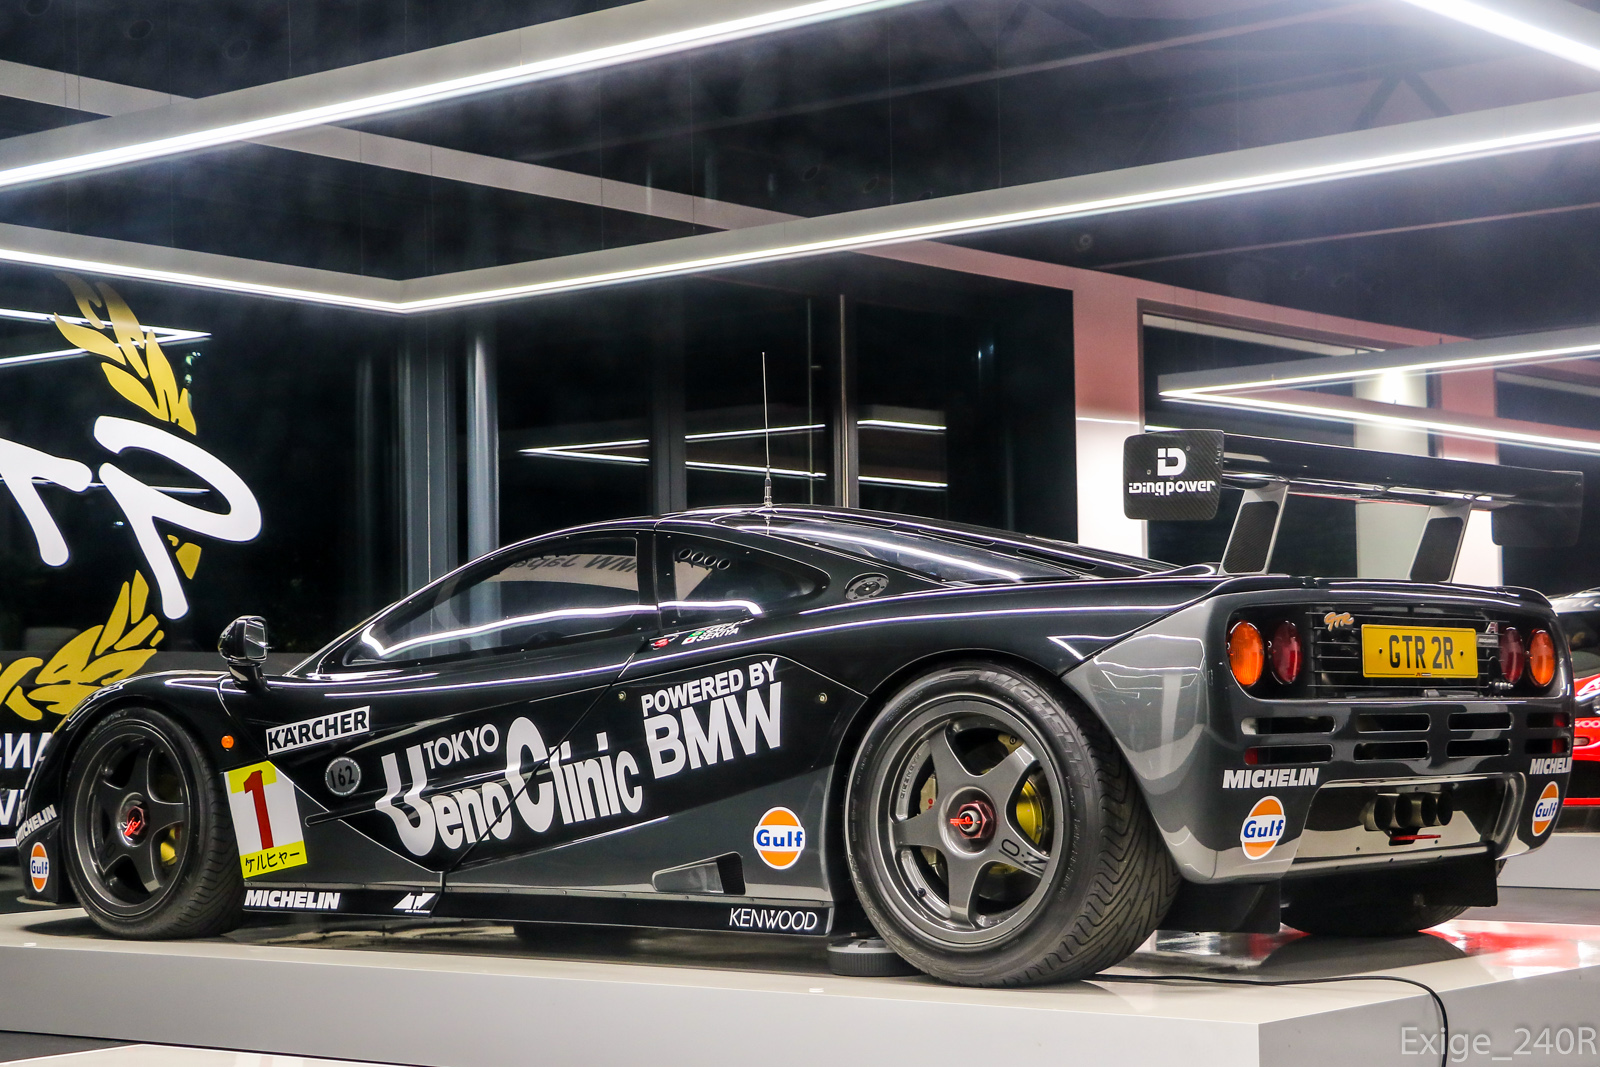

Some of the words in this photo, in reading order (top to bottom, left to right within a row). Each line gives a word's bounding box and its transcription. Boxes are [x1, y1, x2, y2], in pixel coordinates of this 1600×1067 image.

[1324, 612, 1354, 631] GTR
[1389, 634, 1426, 669] GTR
[1431, 636, 1454, 669] 2R
[641, 670, 744, 718] POWERED
[749, 657, 779, 688] BY
[268, 710, 368, 752] KÄRCHER
[643, 681, 783, 779] BMW
[424, 723, 500, 767] TOKYO
[330, 765, 356, 788] 162
[375, 742, 514, 857] Ueno
[505, 716, 643, 834] Clinic
[1222, 767, 1320, 789] MICHELIN
[243, 769, 275, 851] 1
[1534, 800, 1557, 818] Gulf
[755, 828, 804, 848] Gulf
[1243, 819, 1285, 838] Gulf
[31, 860, 48, 875] Gulf
[245, 851, 300, 873] ケルヒャー
[244, 889, 341, 909] MICHELIN
[729, 907, 818, 931] KENWOOD
